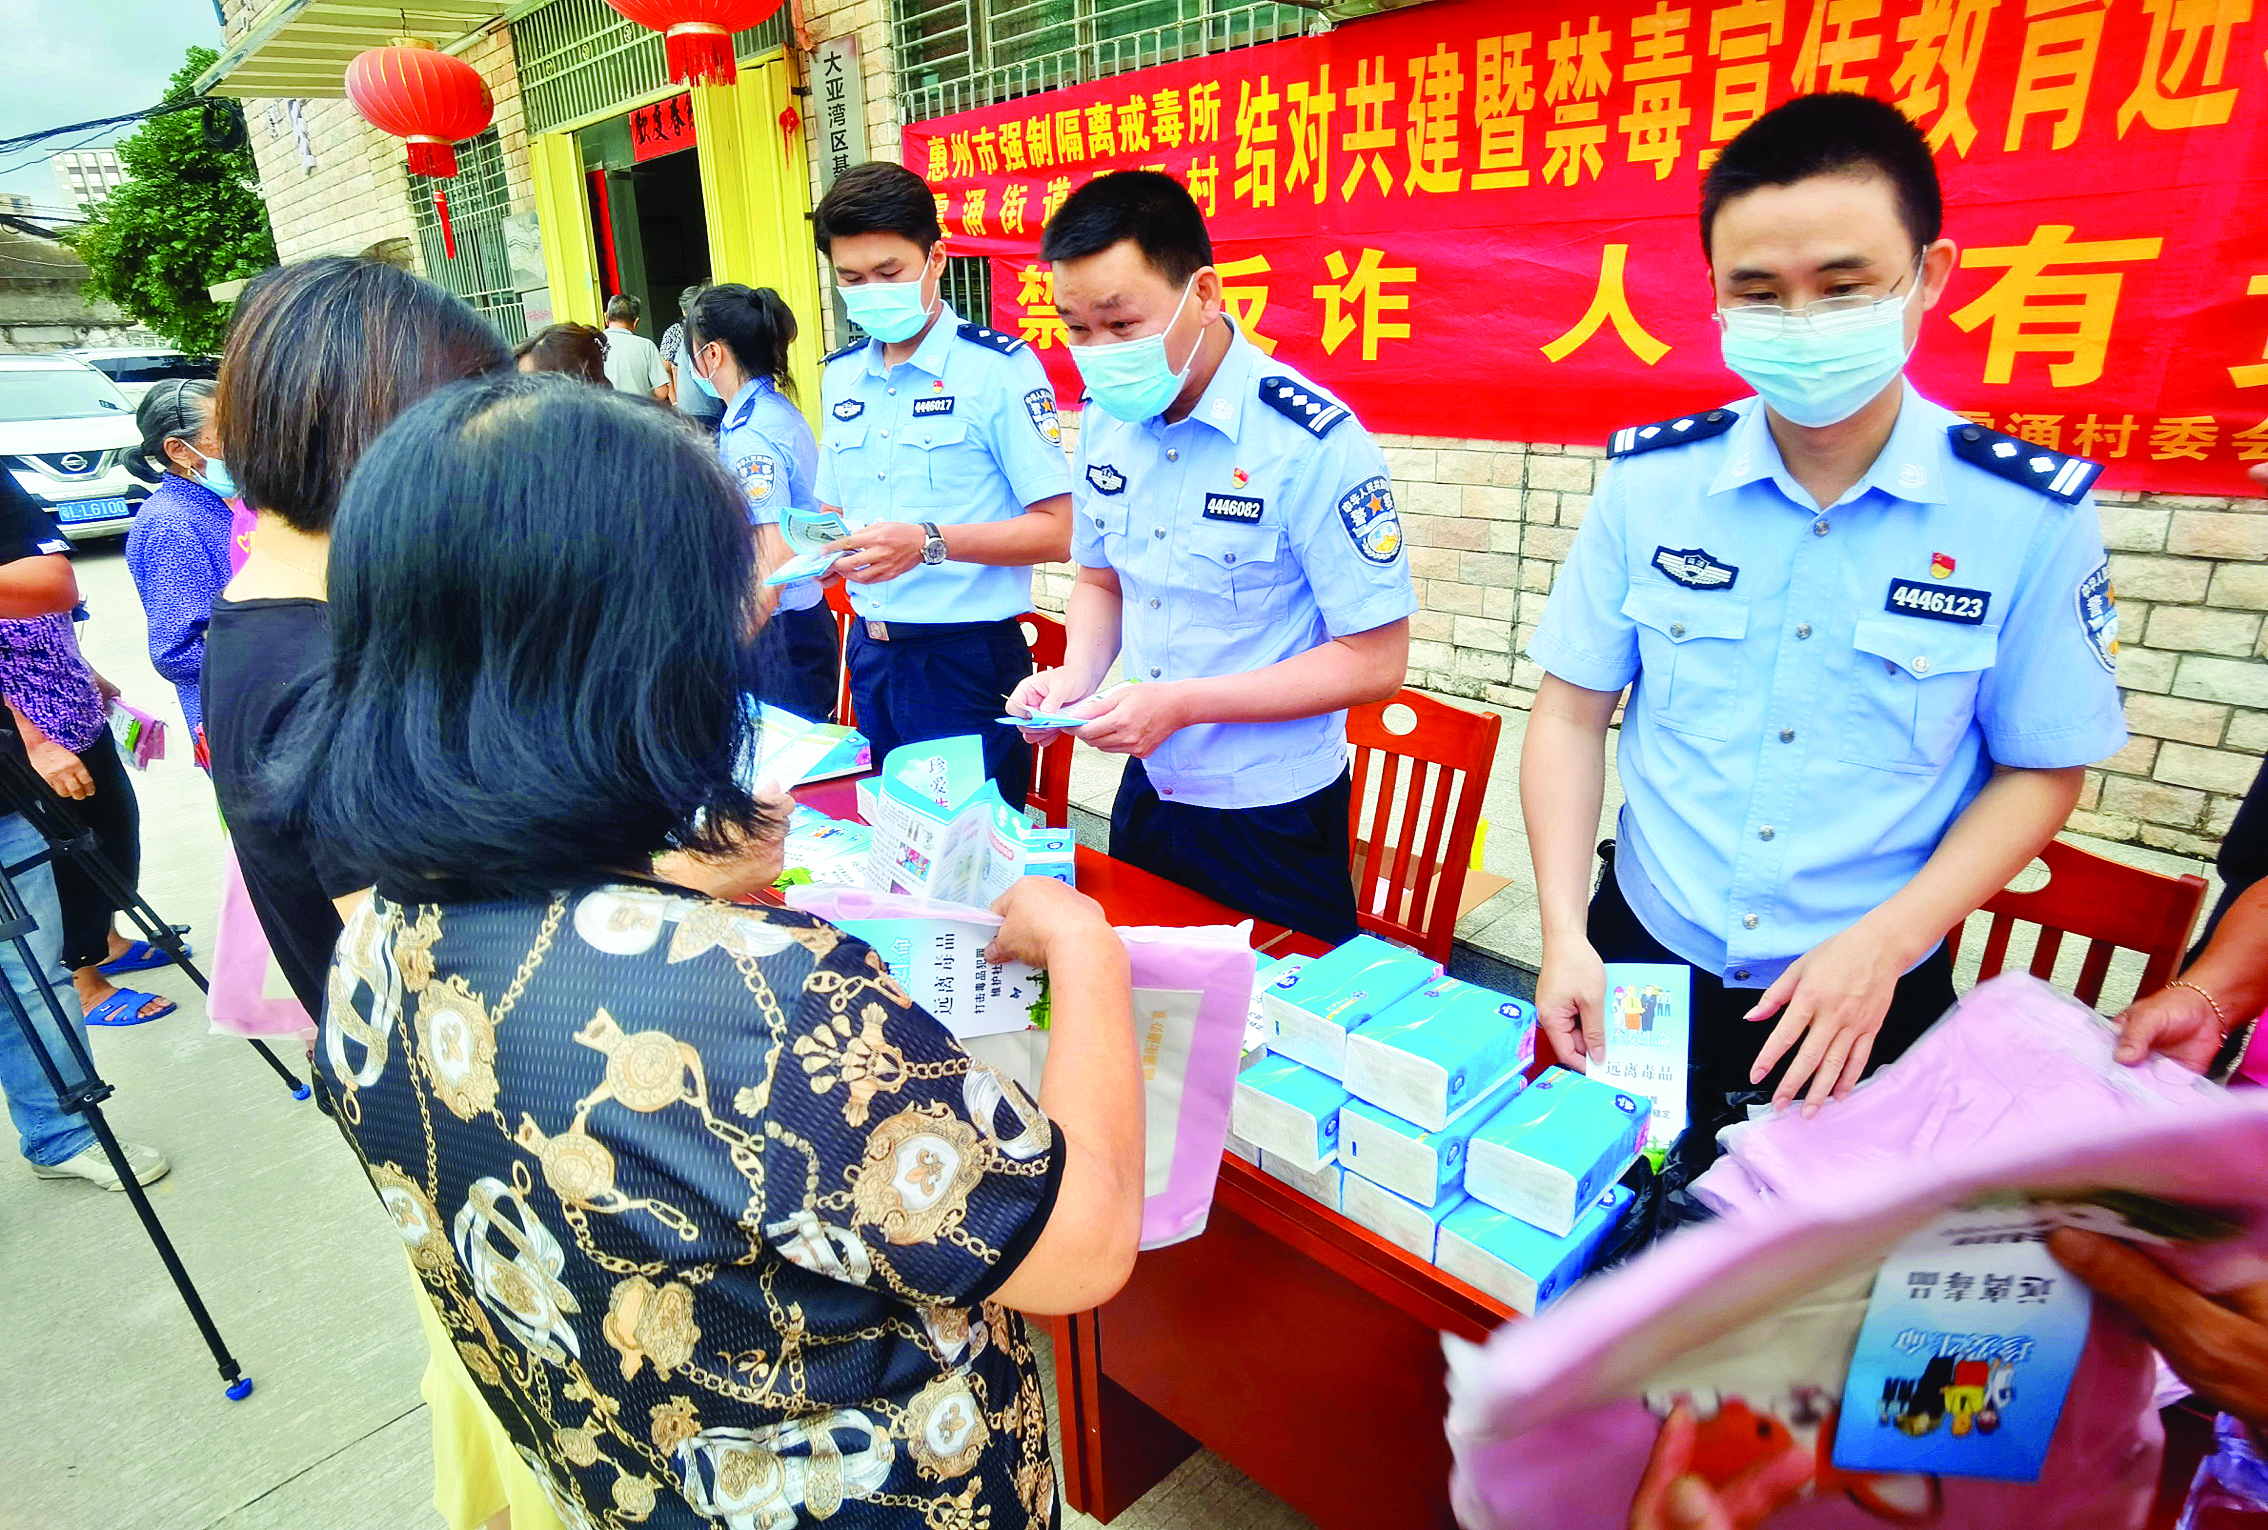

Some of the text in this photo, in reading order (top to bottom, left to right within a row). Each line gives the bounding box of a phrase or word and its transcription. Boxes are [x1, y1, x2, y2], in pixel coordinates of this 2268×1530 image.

[926, 80, 1221, 183] 惠州市强制隔离戒毒所
[932, 155, 1219, 240] 霞涌街道村
[914, 399, 953, 413] 4446017
[1207, 498, 1261, 519] 4446082
[1891, 586, 1983, 618] 4446123
[933, 933, 955, 1015] 远离毒品
[1606, 1061, 1673, 1081] 远离毒品
[1908, 1271, 2056, 1304] 远离毒品
